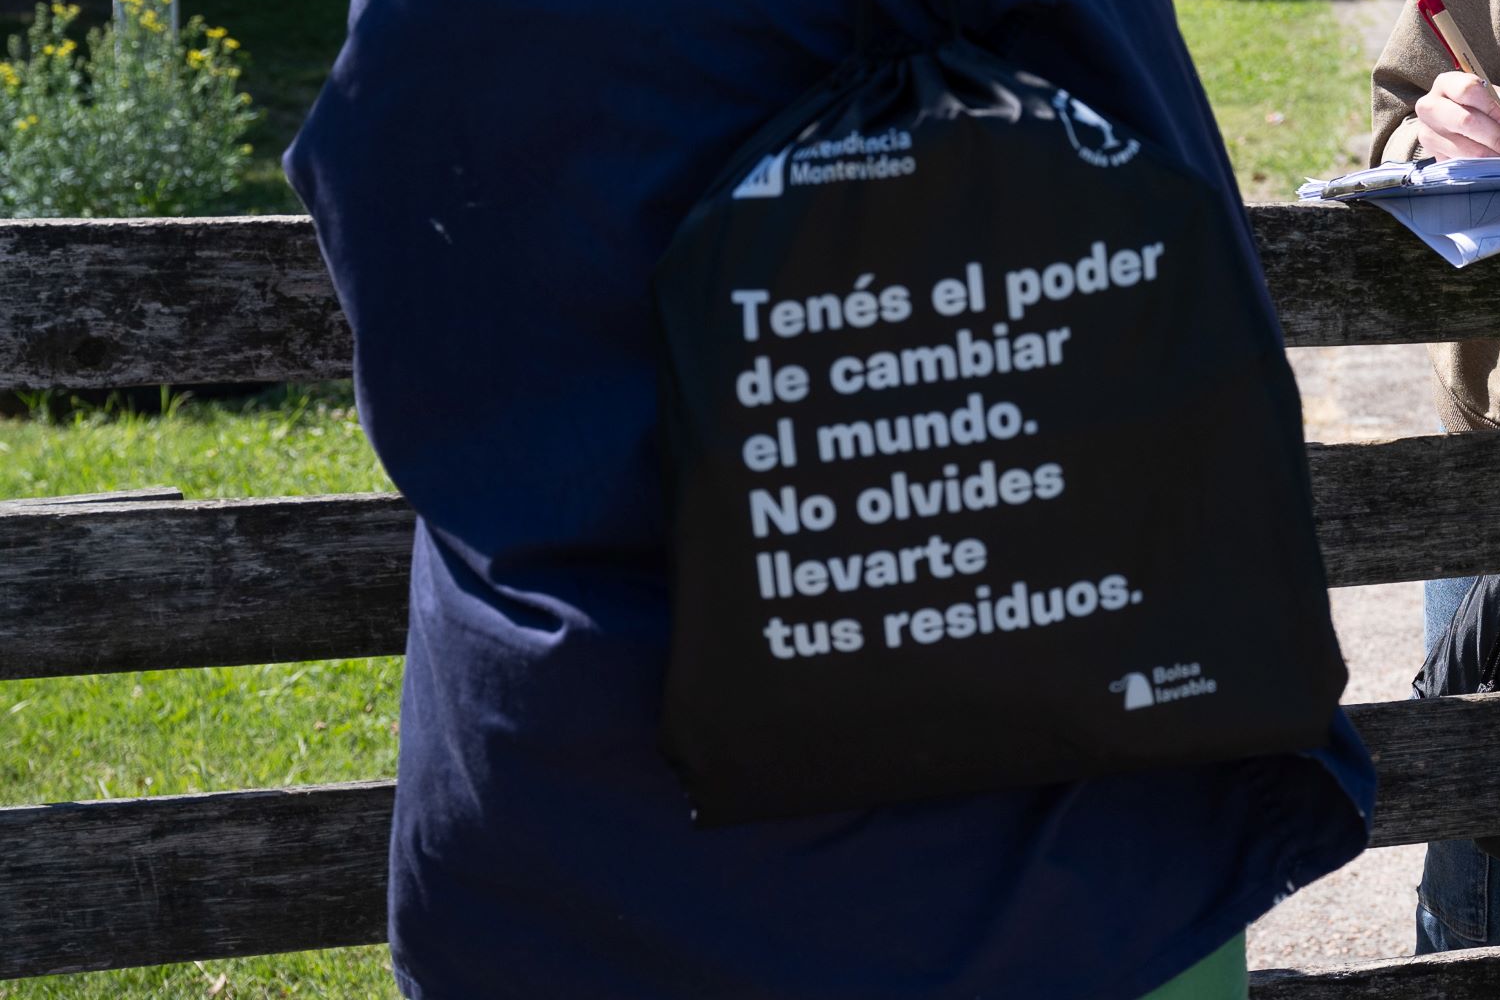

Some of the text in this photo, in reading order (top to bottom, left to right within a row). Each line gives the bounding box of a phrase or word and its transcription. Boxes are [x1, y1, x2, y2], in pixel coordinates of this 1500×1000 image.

[789, 155, 916, 187] Montevideo
[731, 241, 1164, 341] Tenés el poder
[736, 322, 1071, 407] de cambiar
[742, 393, 1038, 472] el mundo.
[749, 461, 1064, 538] No olvides
[756, 535, 987, 599] llevarte
[763, 574, 1142, 659] tus residuos.
[1153, 662, 1201, 685] Bolsa
[1154, 677, 1217, 704] lavable
